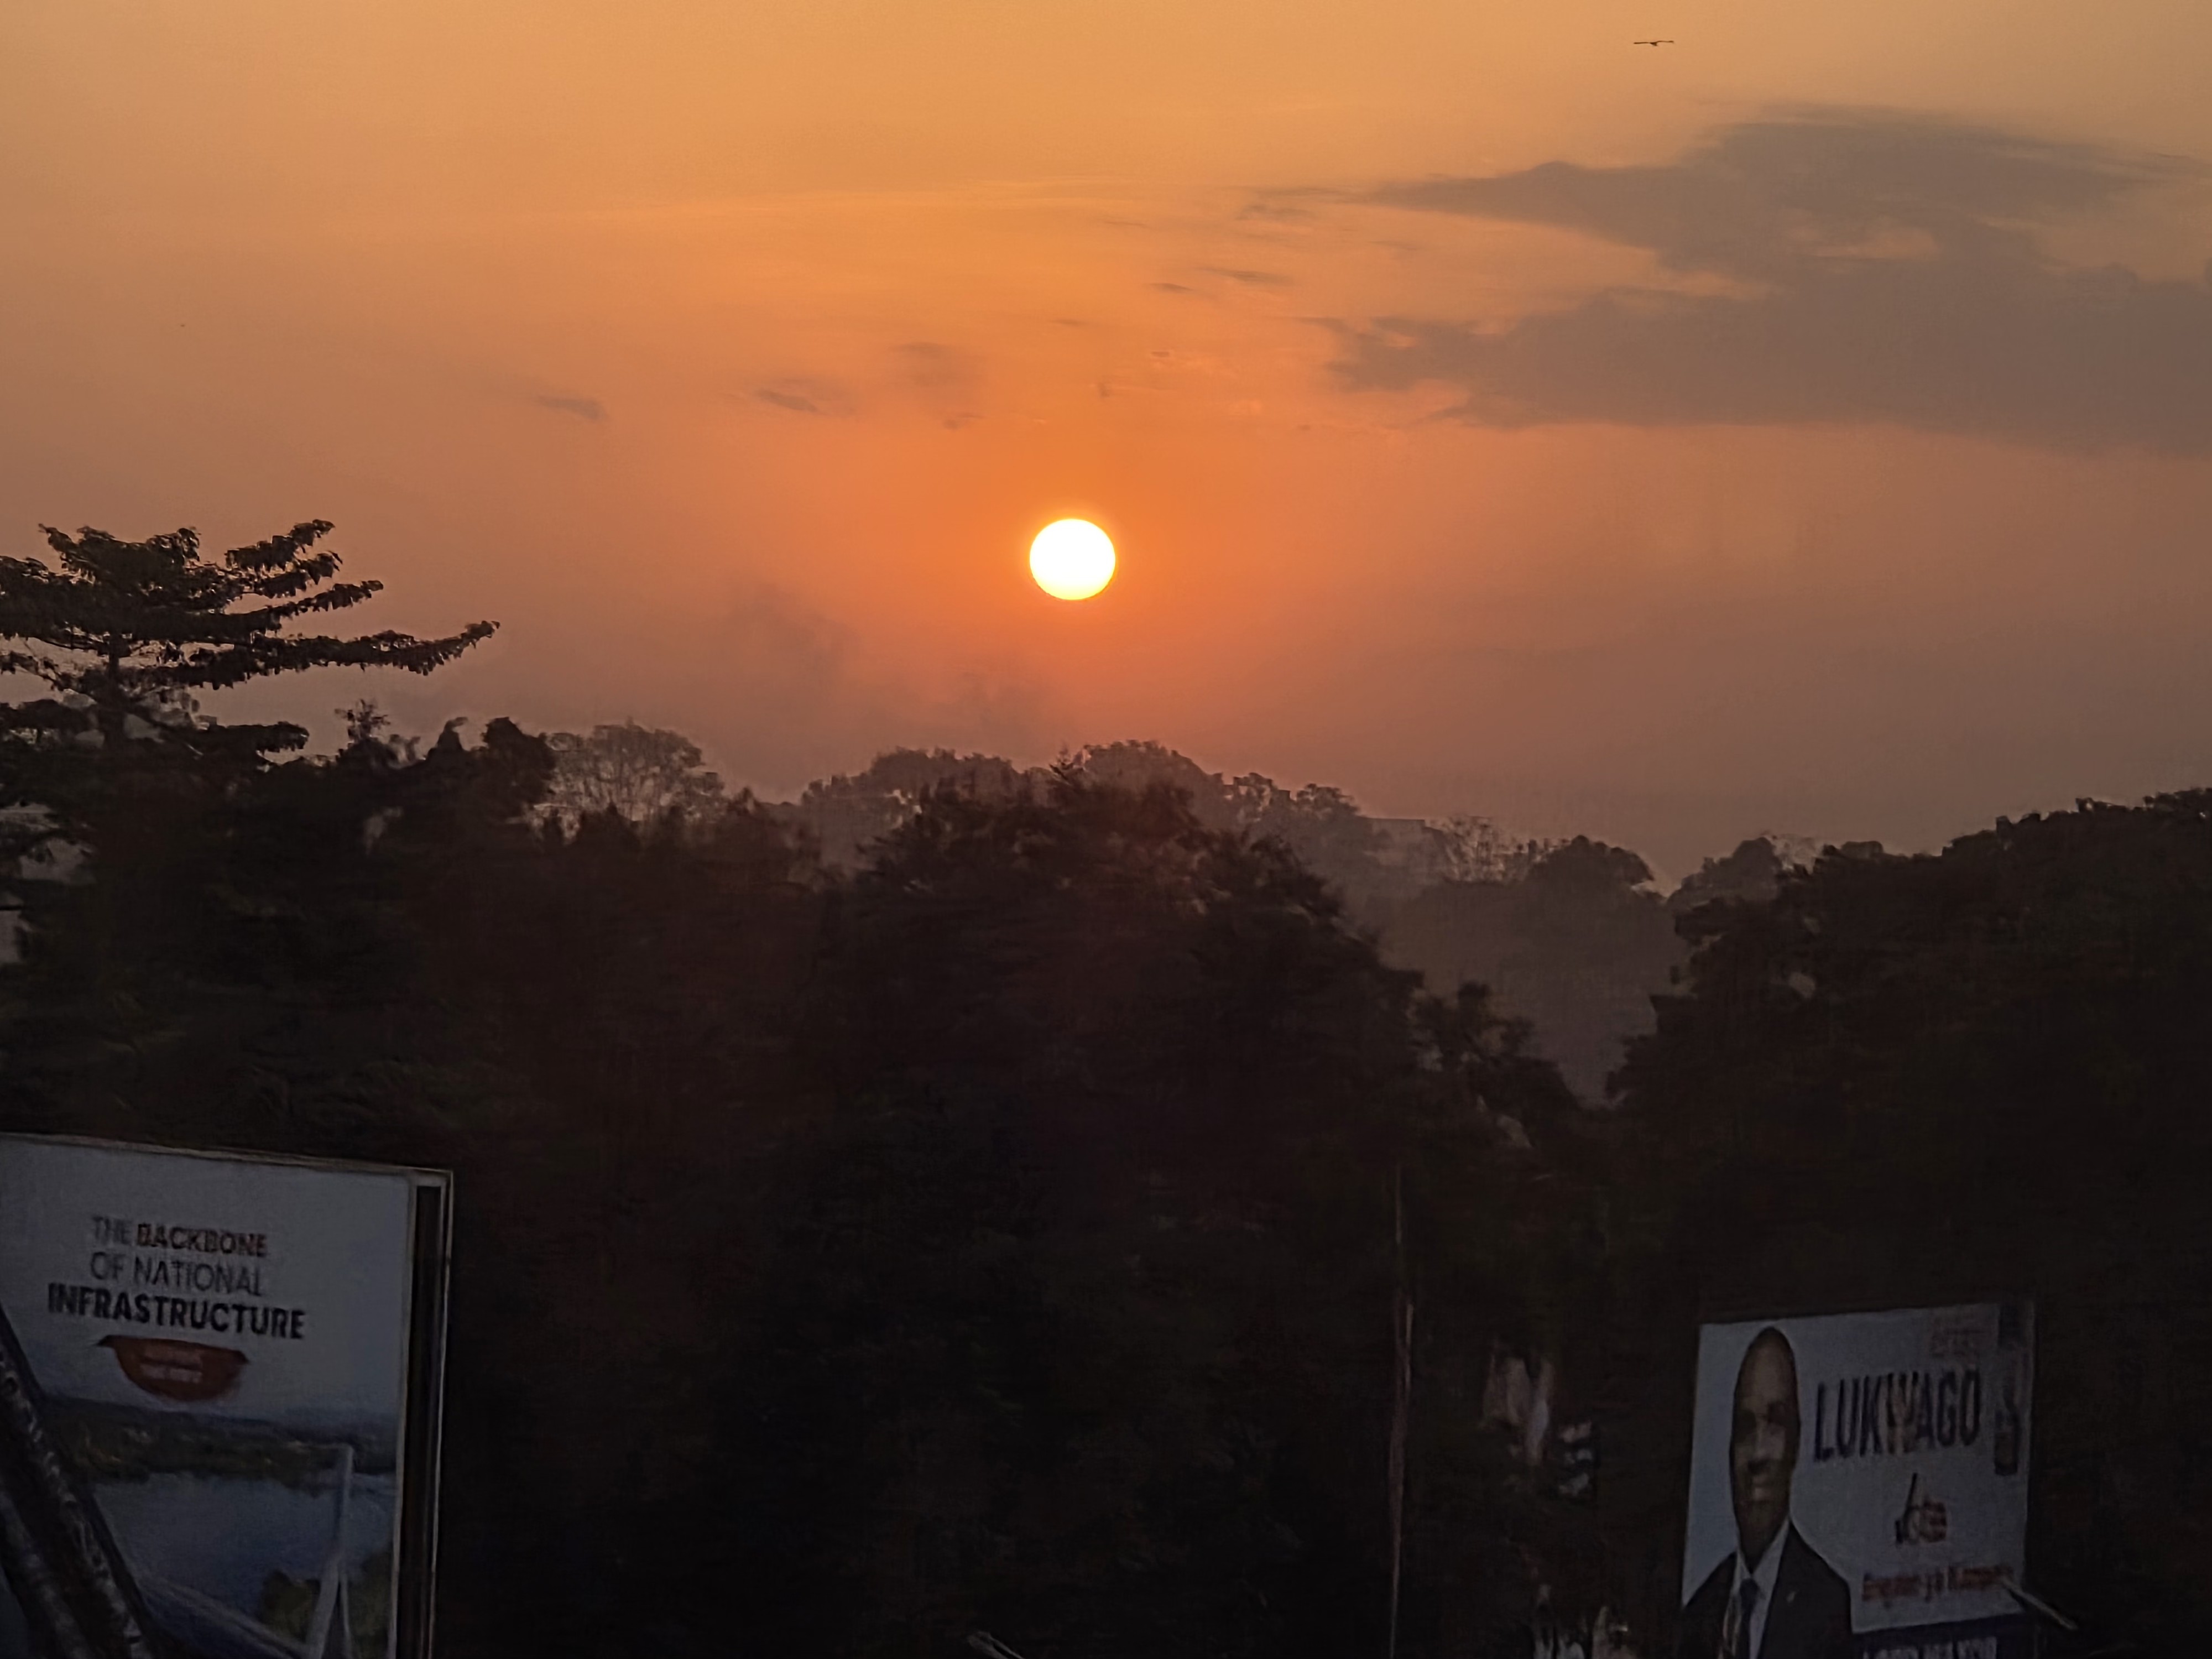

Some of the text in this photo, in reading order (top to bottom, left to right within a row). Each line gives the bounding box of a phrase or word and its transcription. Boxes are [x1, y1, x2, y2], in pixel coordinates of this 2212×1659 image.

[92, 1217, 267, 1256] THE BACKBONE
[90, 1251, 262, 1296] OF NATIONAL
[48, 1282, 306, 1339] INFRASTRUCTURE
[1815, 1369, 1980, 1460] LUKWAGO
